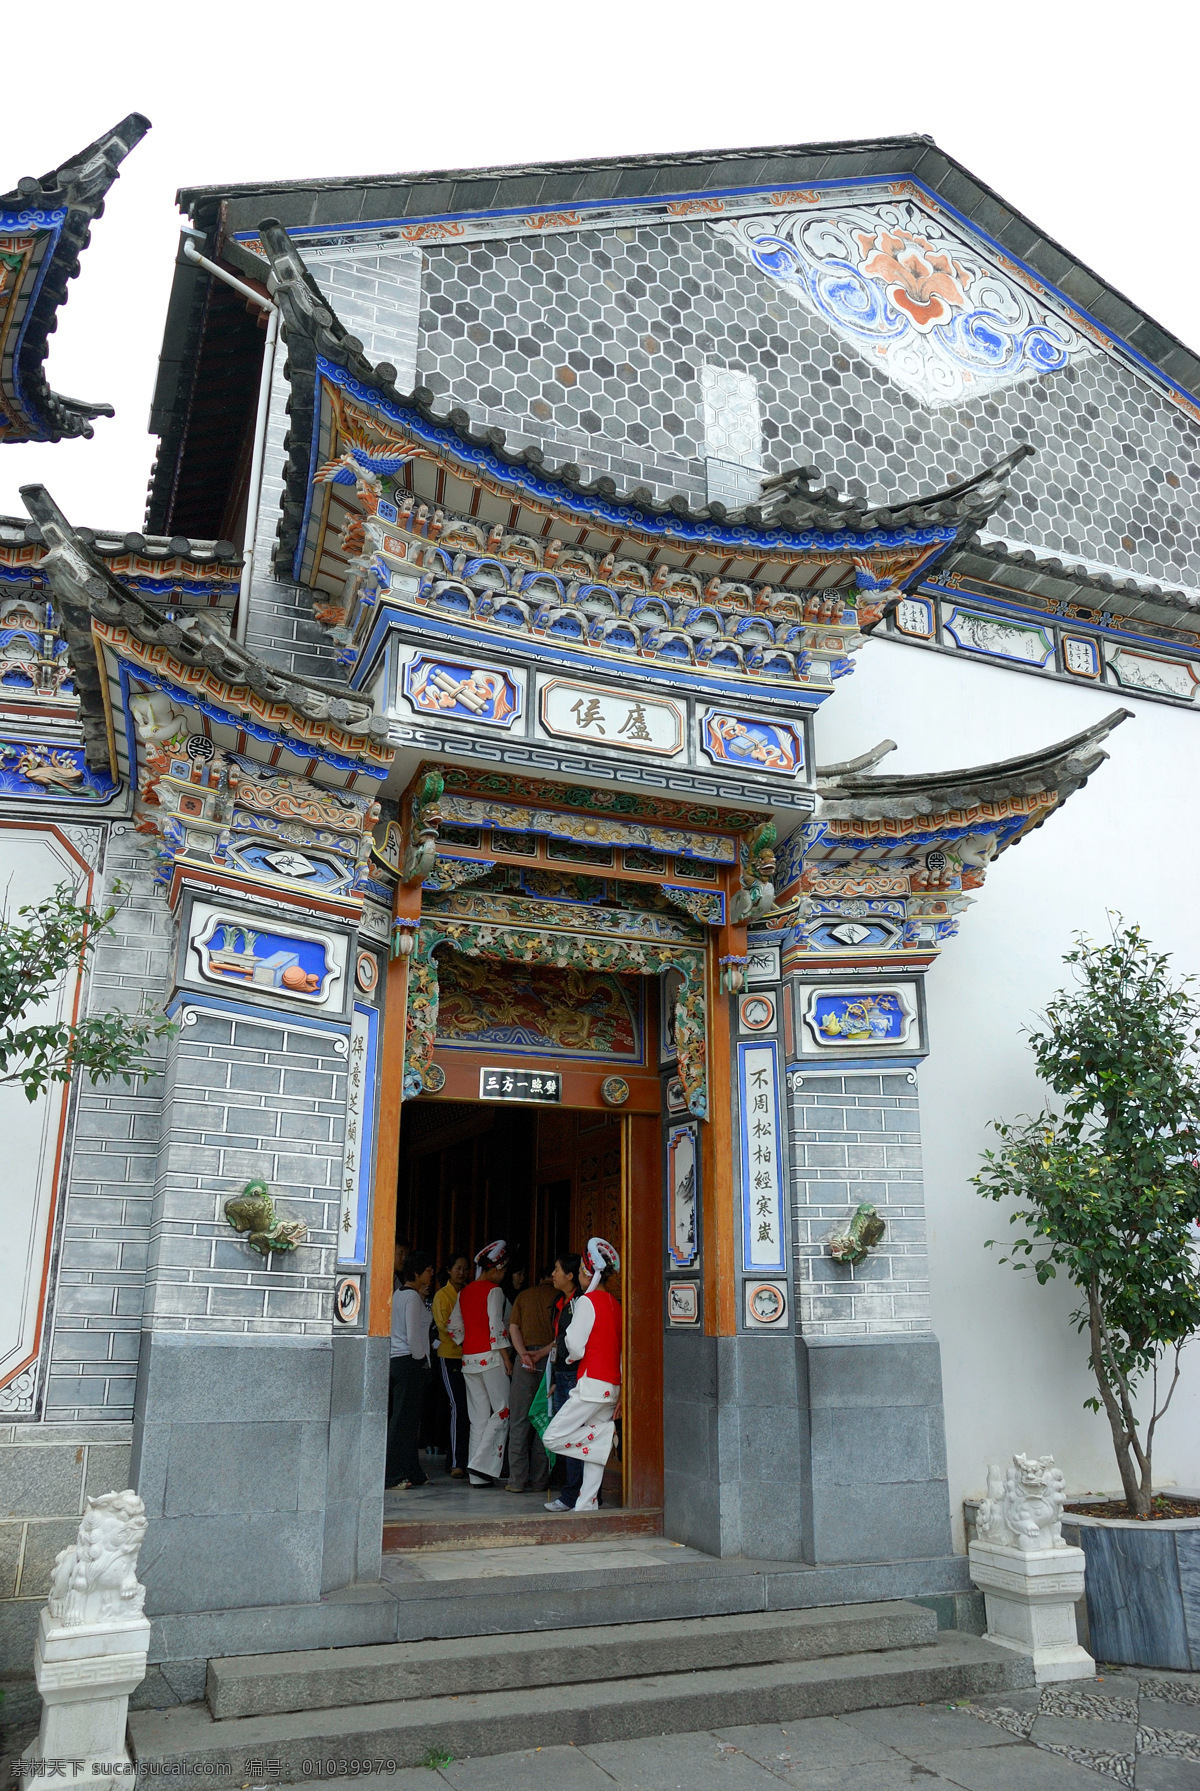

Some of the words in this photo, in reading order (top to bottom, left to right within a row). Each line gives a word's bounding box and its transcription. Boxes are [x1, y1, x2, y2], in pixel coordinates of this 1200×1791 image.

[485, 1076, 557, 1095] 三方一照壁
